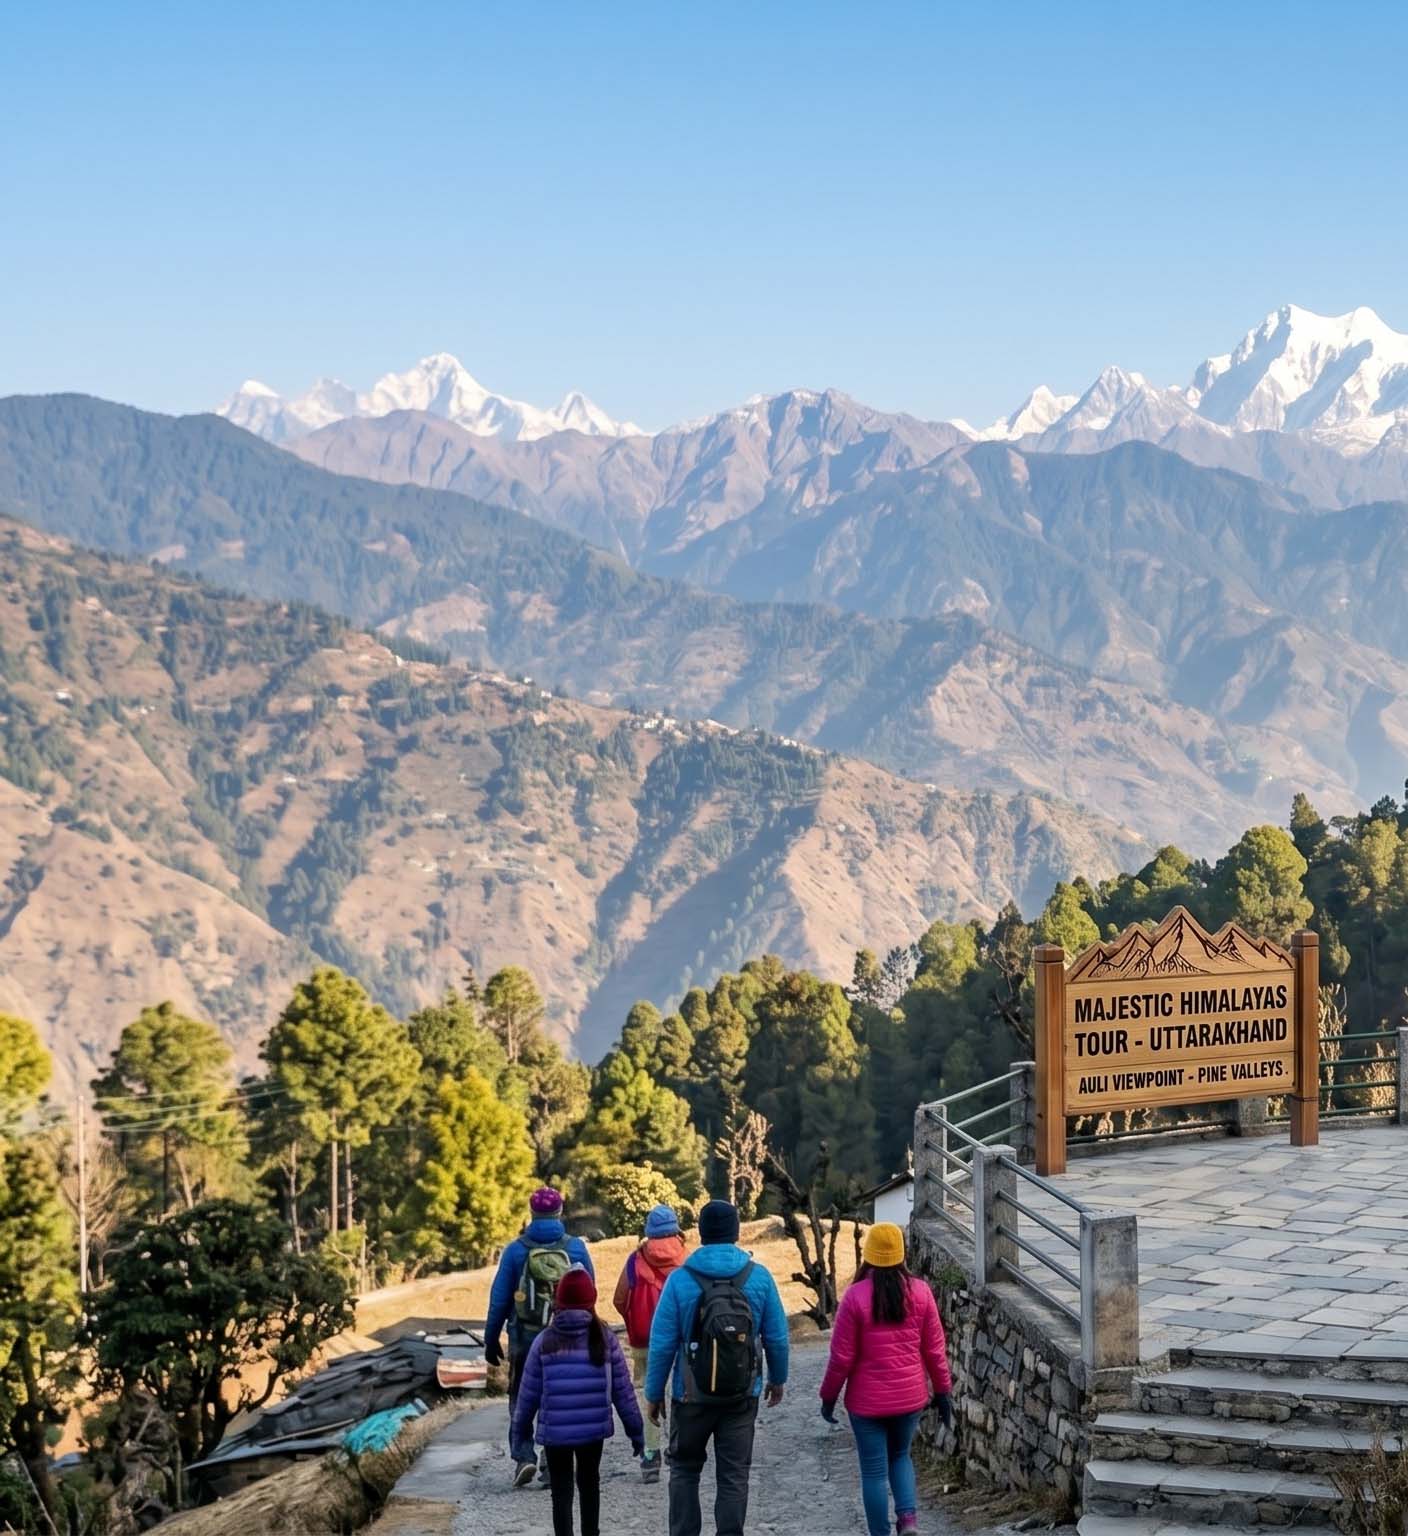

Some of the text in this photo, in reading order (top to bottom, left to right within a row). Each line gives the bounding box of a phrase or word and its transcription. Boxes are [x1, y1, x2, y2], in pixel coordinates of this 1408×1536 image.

[1074, 985, 1287, 1023] MAJESTIC HIMALAYAS
[1074, 1030, 1128, 1057] TOUR
[1150, 1017, 1287, 1051] UTTARAKHAND
[1078, 1075, 1108, 1094] AULI
[1112, 1068, 1185, 1091] VIEWPOINT
[1198, 1065, 1227, 1084] PINE
